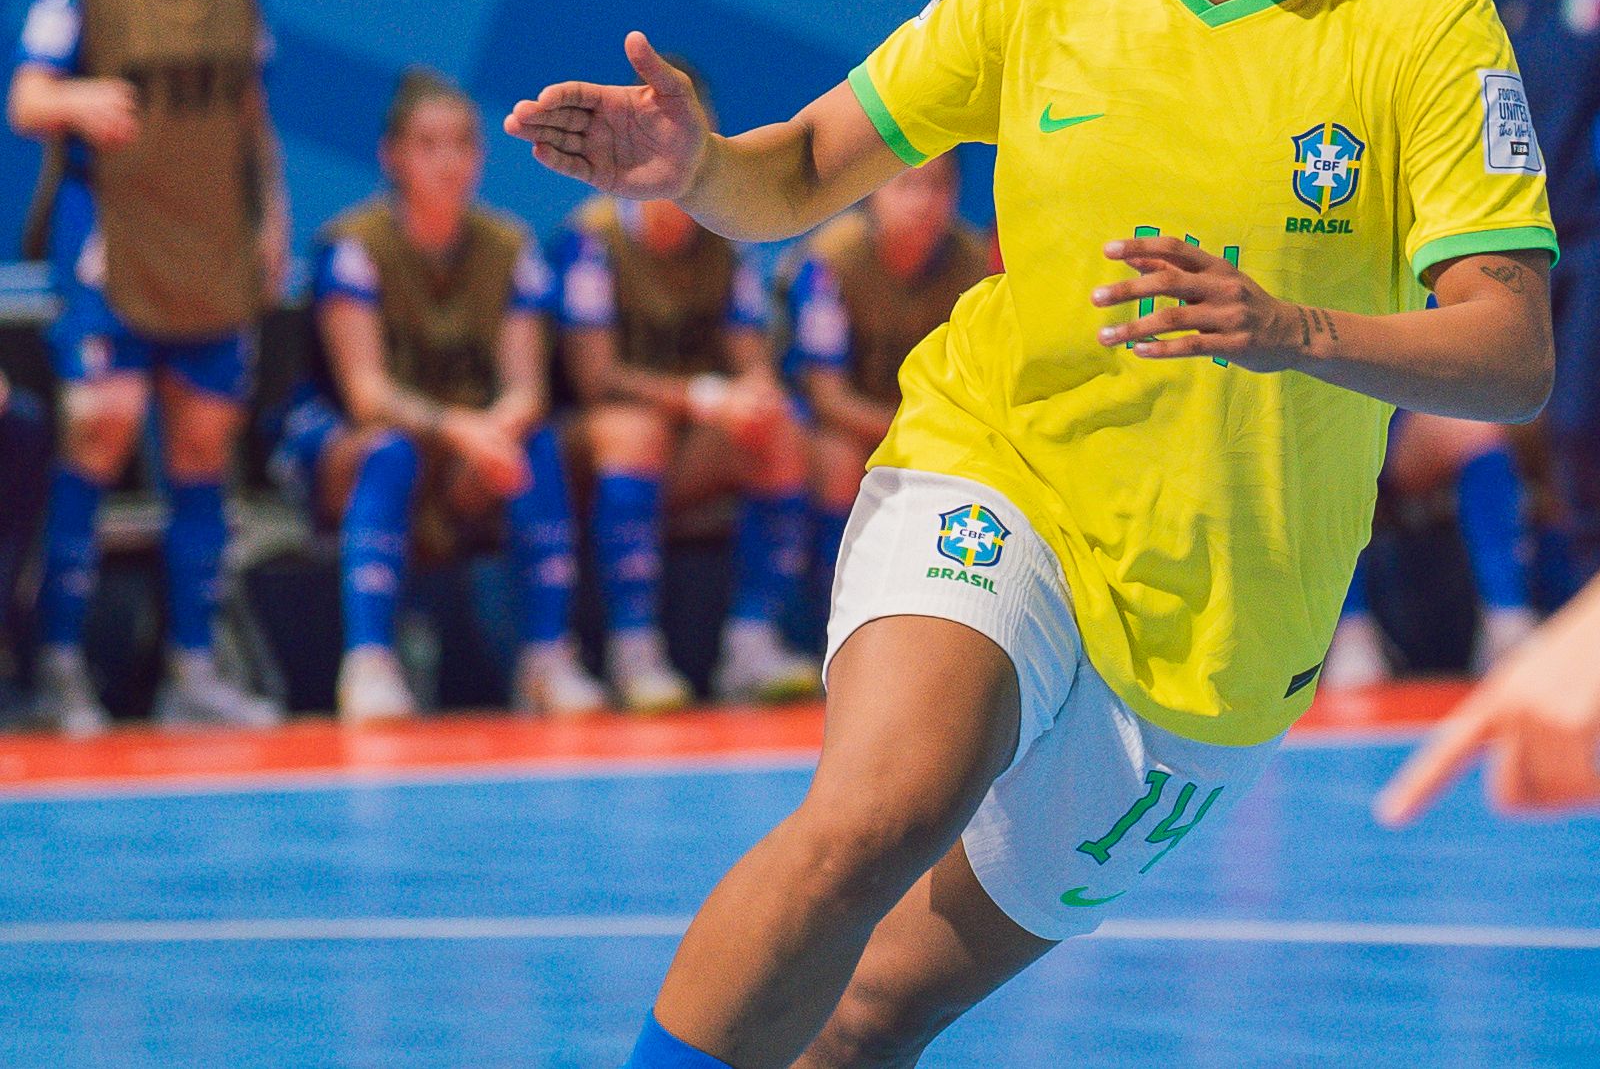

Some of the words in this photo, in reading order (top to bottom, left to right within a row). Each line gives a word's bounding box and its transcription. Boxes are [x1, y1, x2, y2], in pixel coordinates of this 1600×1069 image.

[1313, 159, 1341, 172] CBF
[1285, 217, 1353, 234] BRASIL
[959, 528, 987, 540] CBF
[926, 567, 998, 595] BRASIL
[1076, 769, 1225, 875] 14
